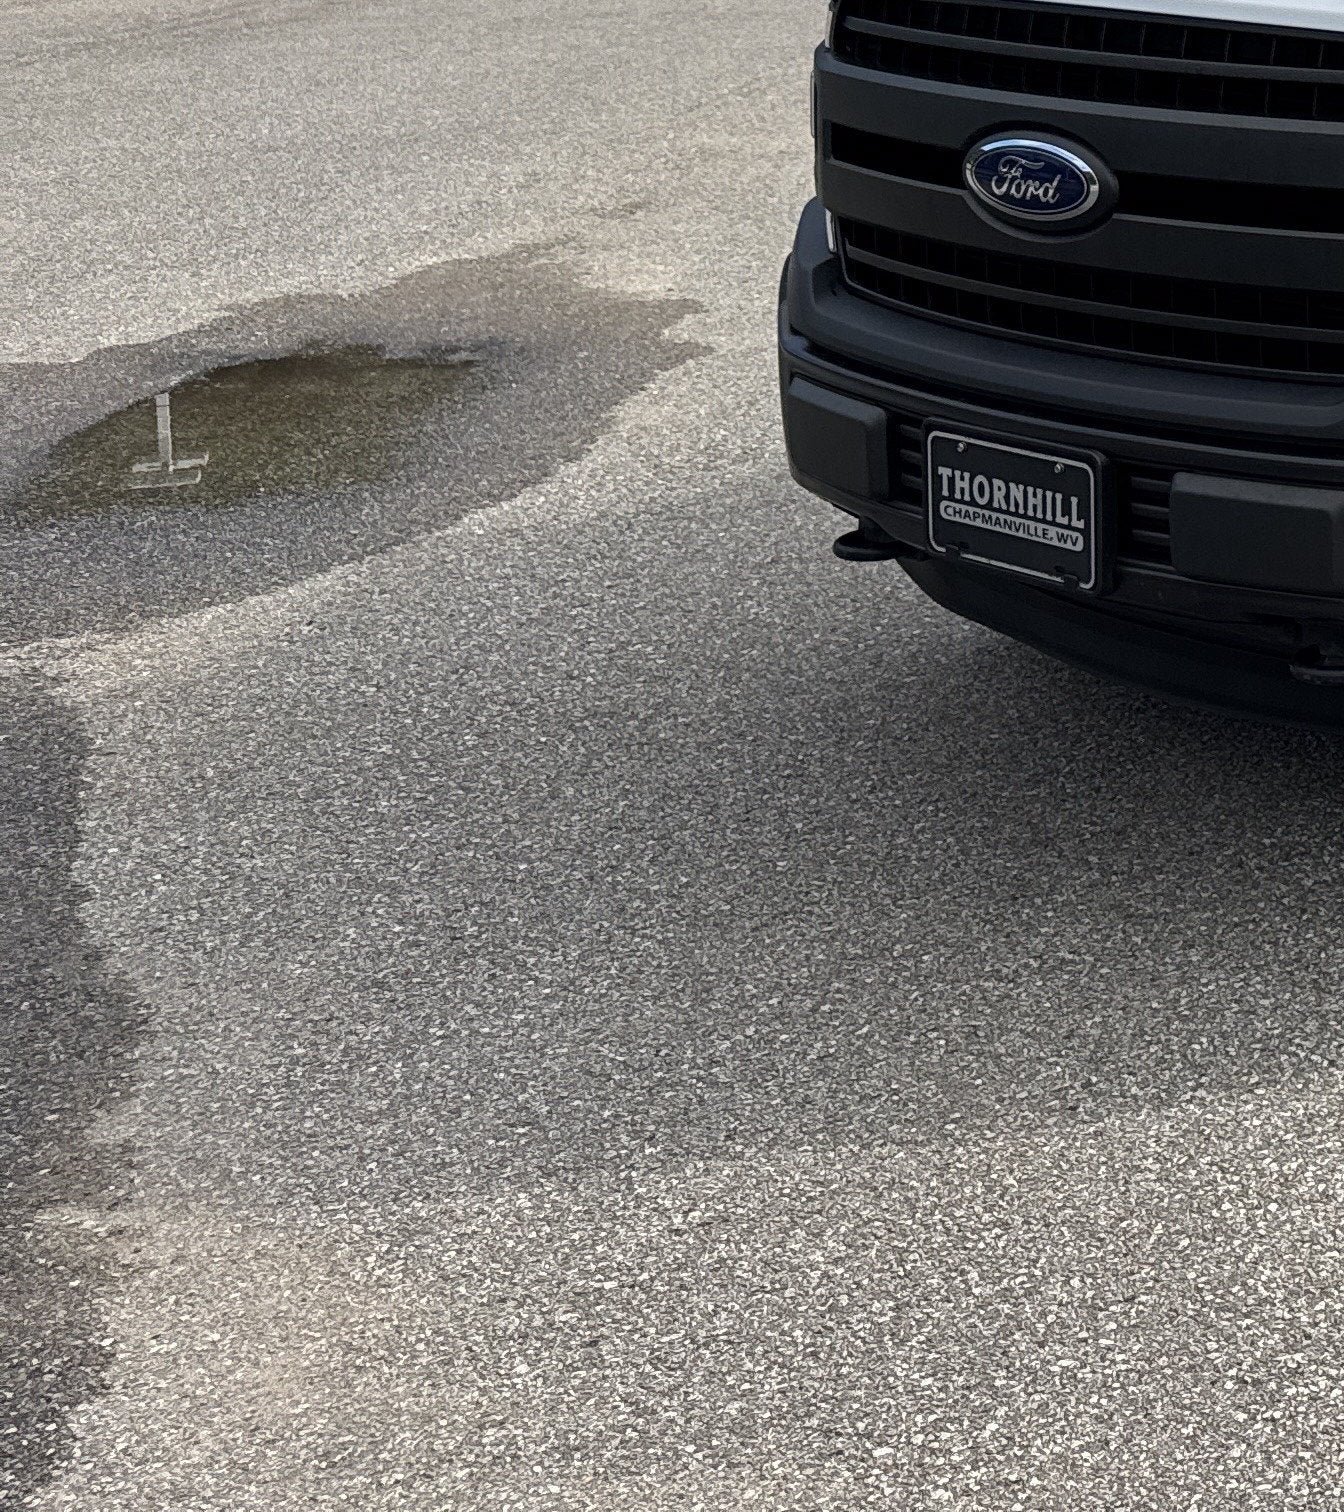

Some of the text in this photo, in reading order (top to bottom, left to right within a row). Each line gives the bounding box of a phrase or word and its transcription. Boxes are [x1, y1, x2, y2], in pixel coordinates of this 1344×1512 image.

[991, 155, 1061, 203] Ford
[938, 466, 1086, 529] THORNHILL
[944, 504, 1080, 547] CHAPMANVILLE, WV
